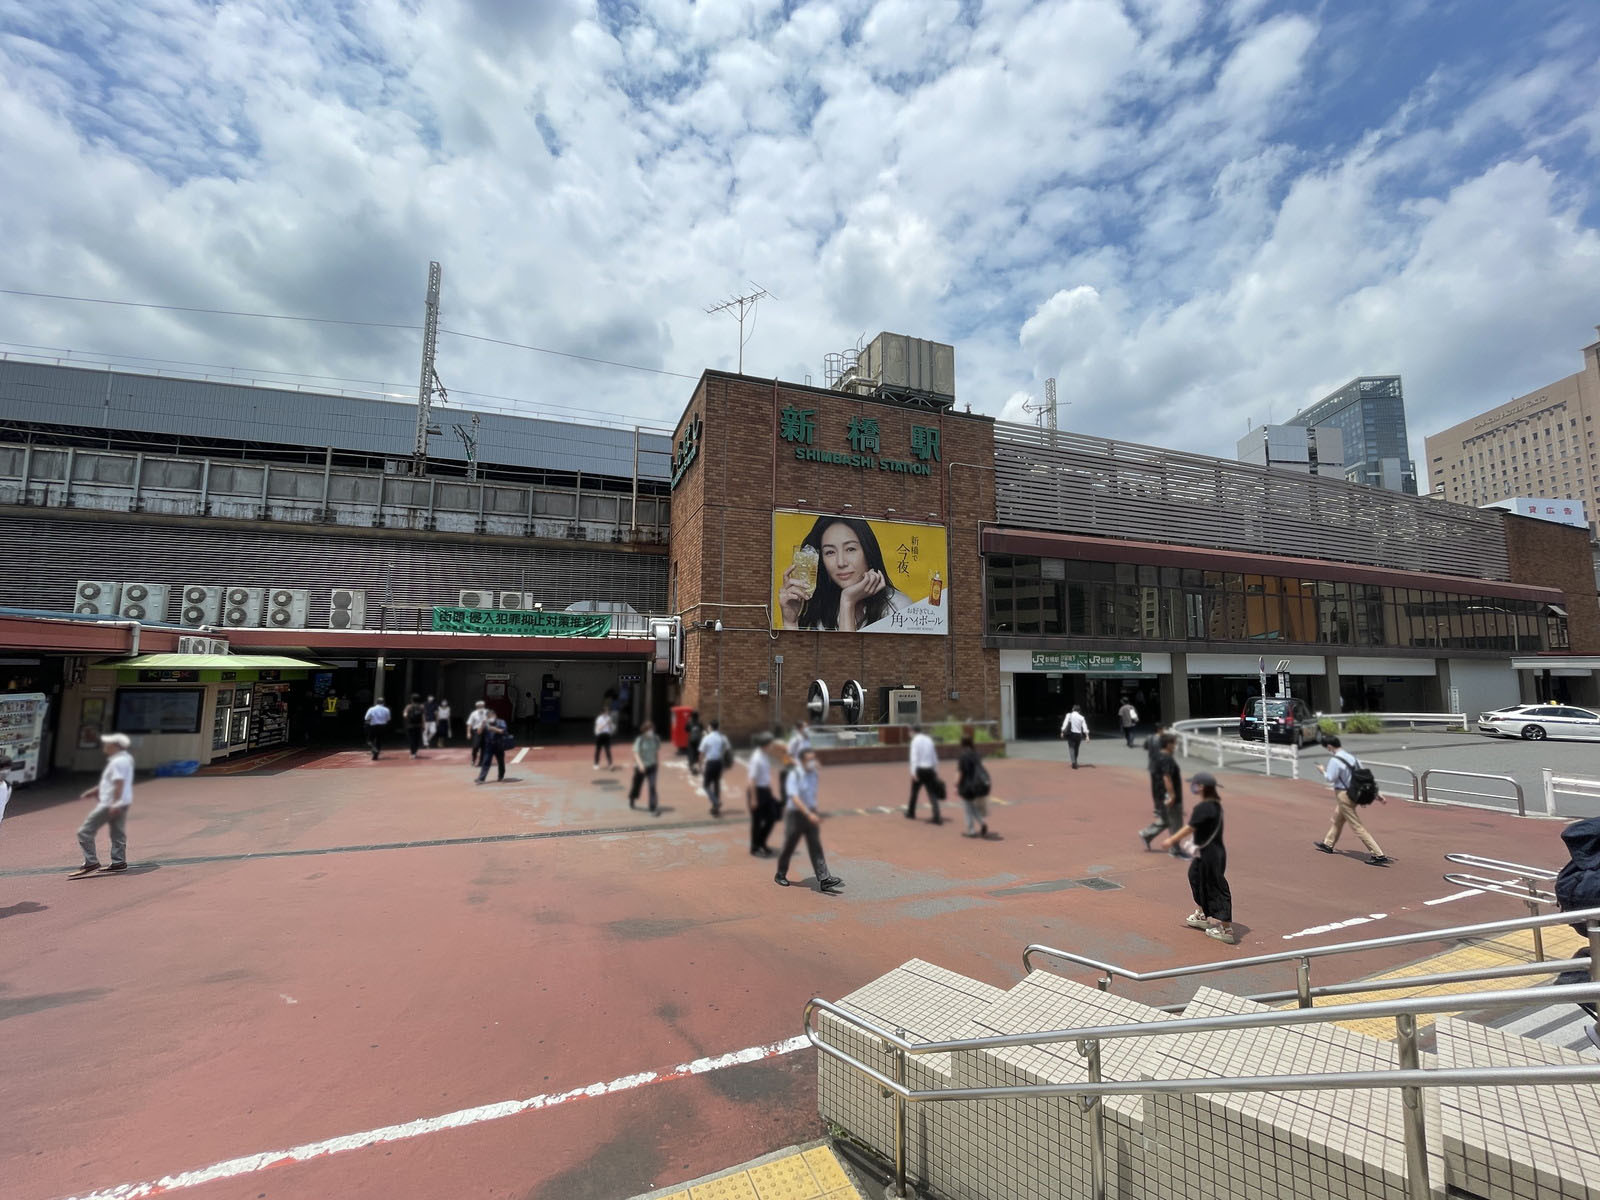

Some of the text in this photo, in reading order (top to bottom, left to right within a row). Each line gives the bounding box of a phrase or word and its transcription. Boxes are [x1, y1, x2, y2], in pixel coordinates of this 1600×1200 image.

[780, 405, 941, 462] 新橋駅
[795, 447, 931, 476] SHIMBASHI STATION
[911, 535, 920, 562] 新橋で
[891, 612, 943, 627] 角ハイボール
[1033, 655, 1044, 663] JR
[1089, 656, 1100, 664] JR
